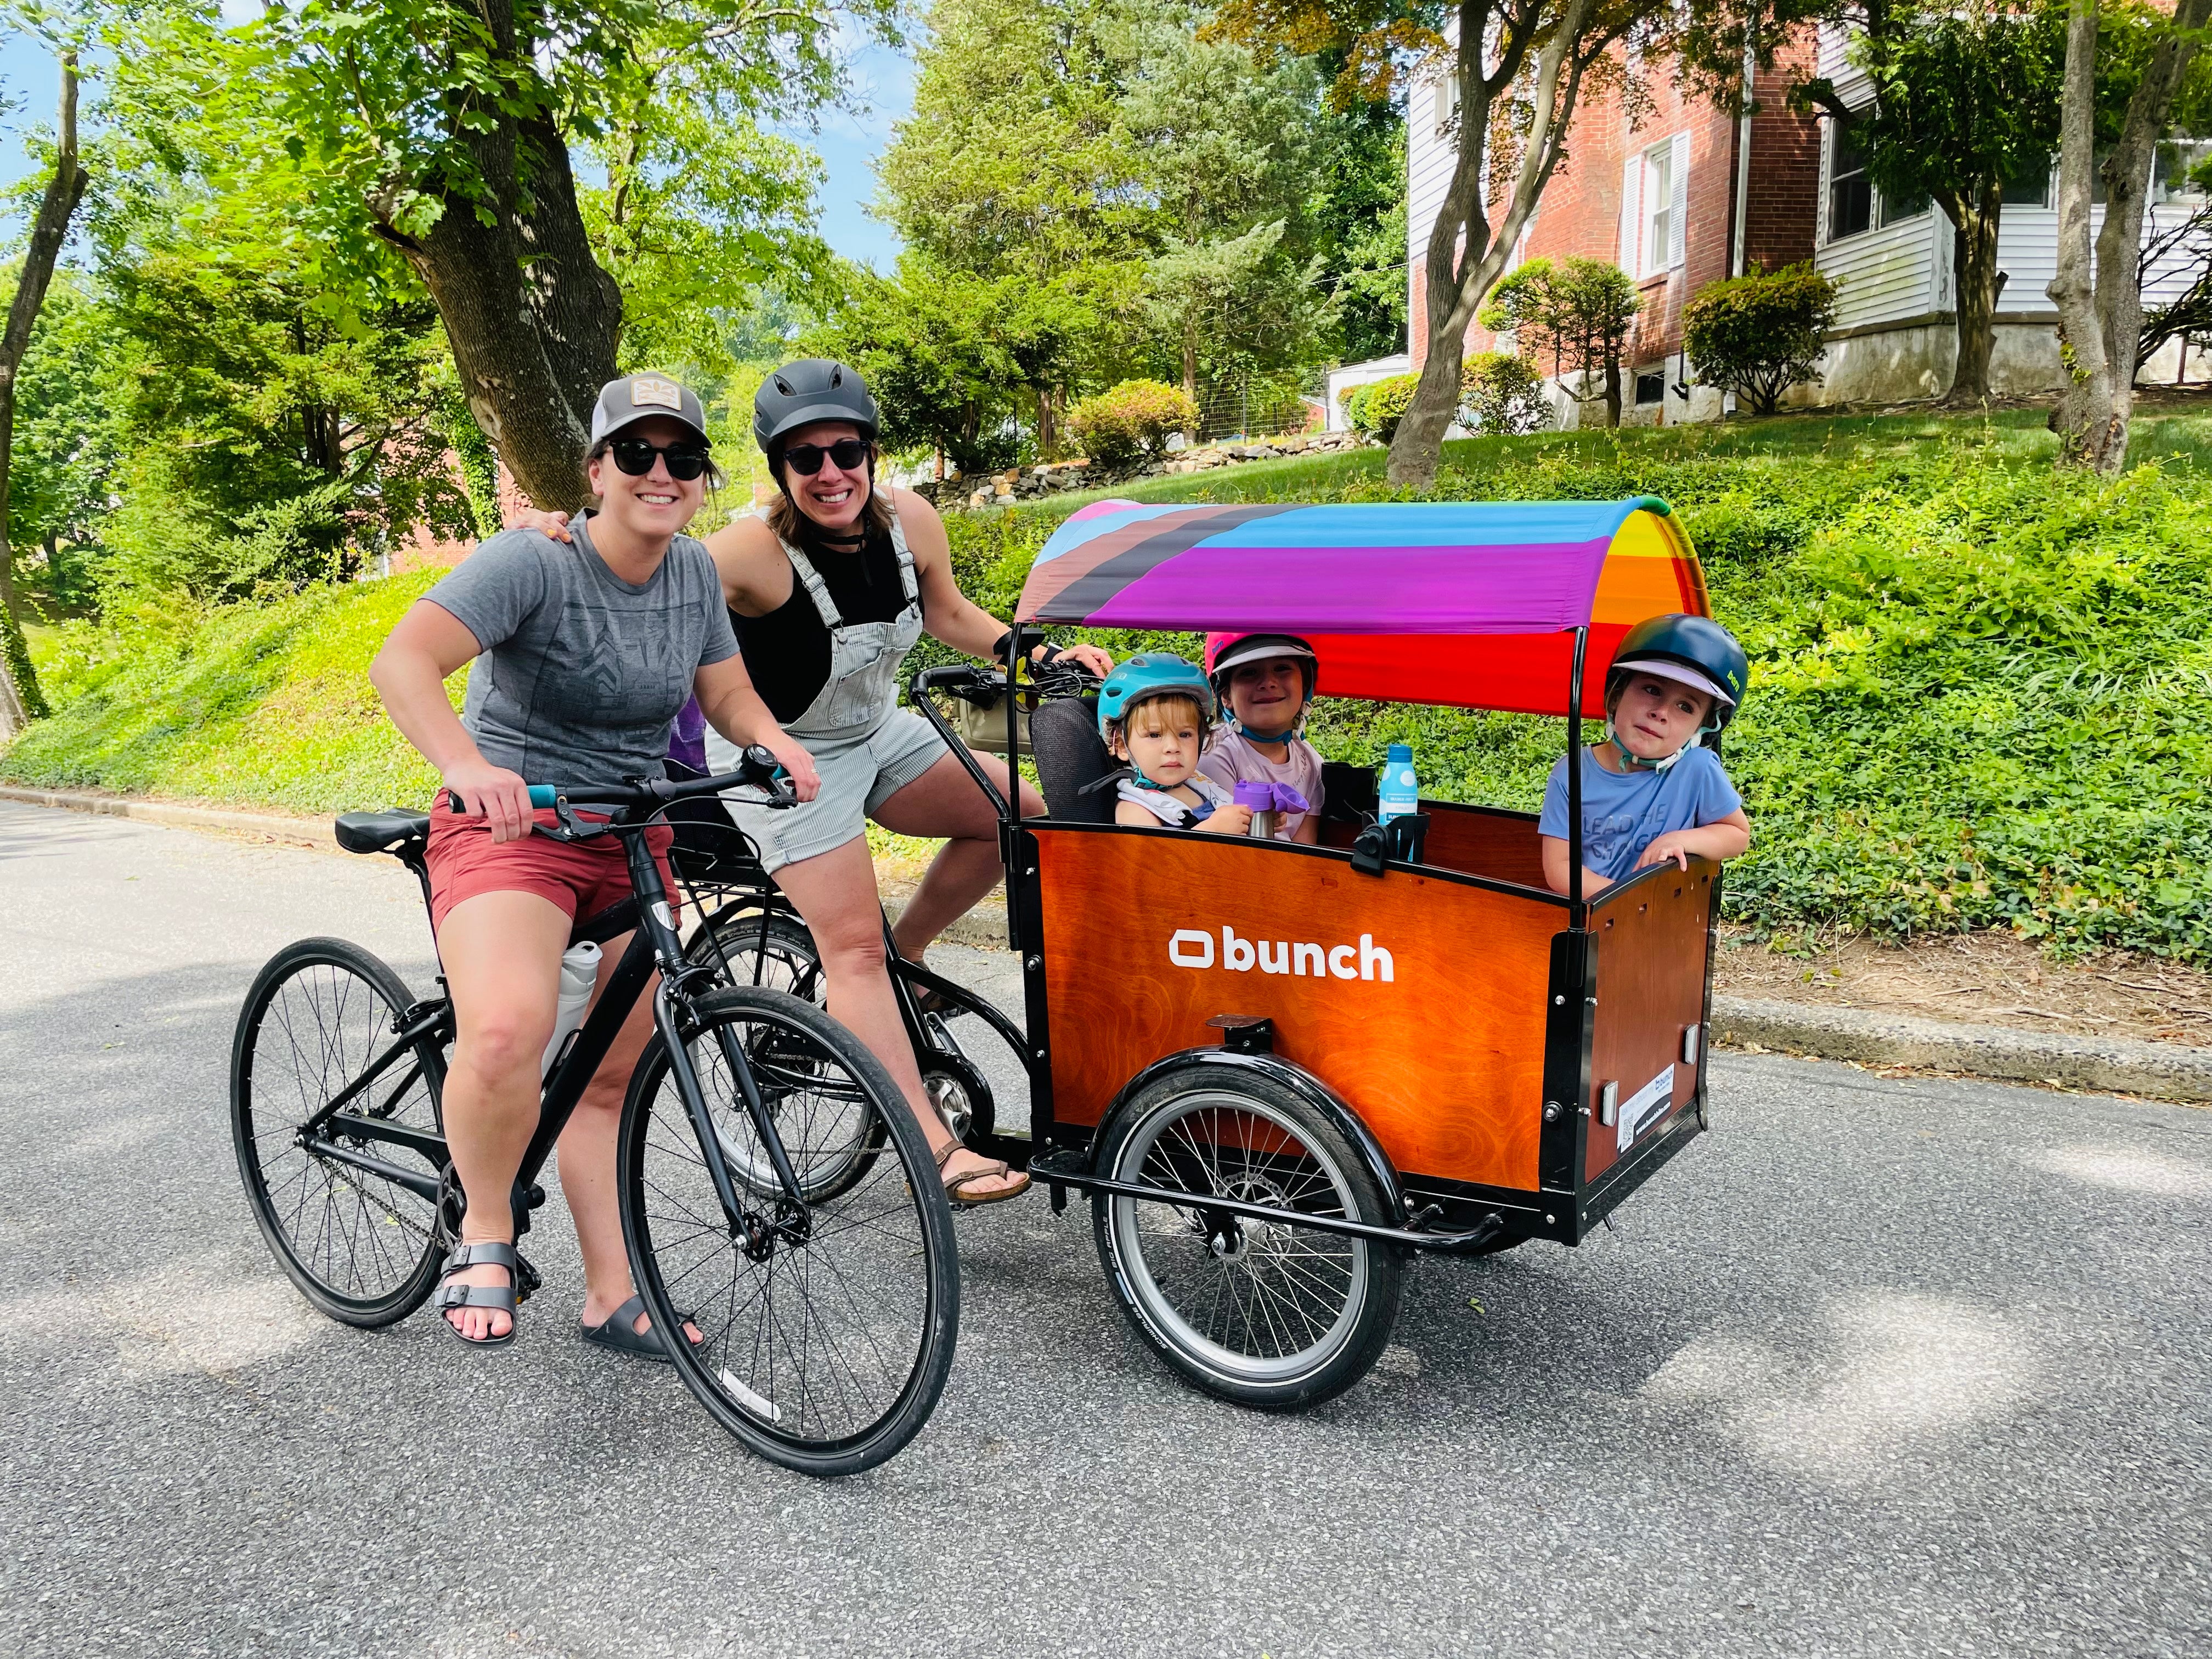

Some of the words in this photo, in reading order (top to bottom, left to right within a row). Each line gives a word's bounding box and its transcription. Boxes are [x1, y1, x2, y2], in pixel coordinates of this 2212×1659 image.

[1583, 815, 1634, 835] LEAD
[1640, 803, 1667, 825] HE
[1590, 831, 1661, 860] CHGE
[1222, 926, 1394, 982] bunch
[1103, 1216, 1113, 1248] APPLE
[1108, 1253, 1118, 1268] BIG
[1132, 1306, 1169, 1350] SCHWALBE
